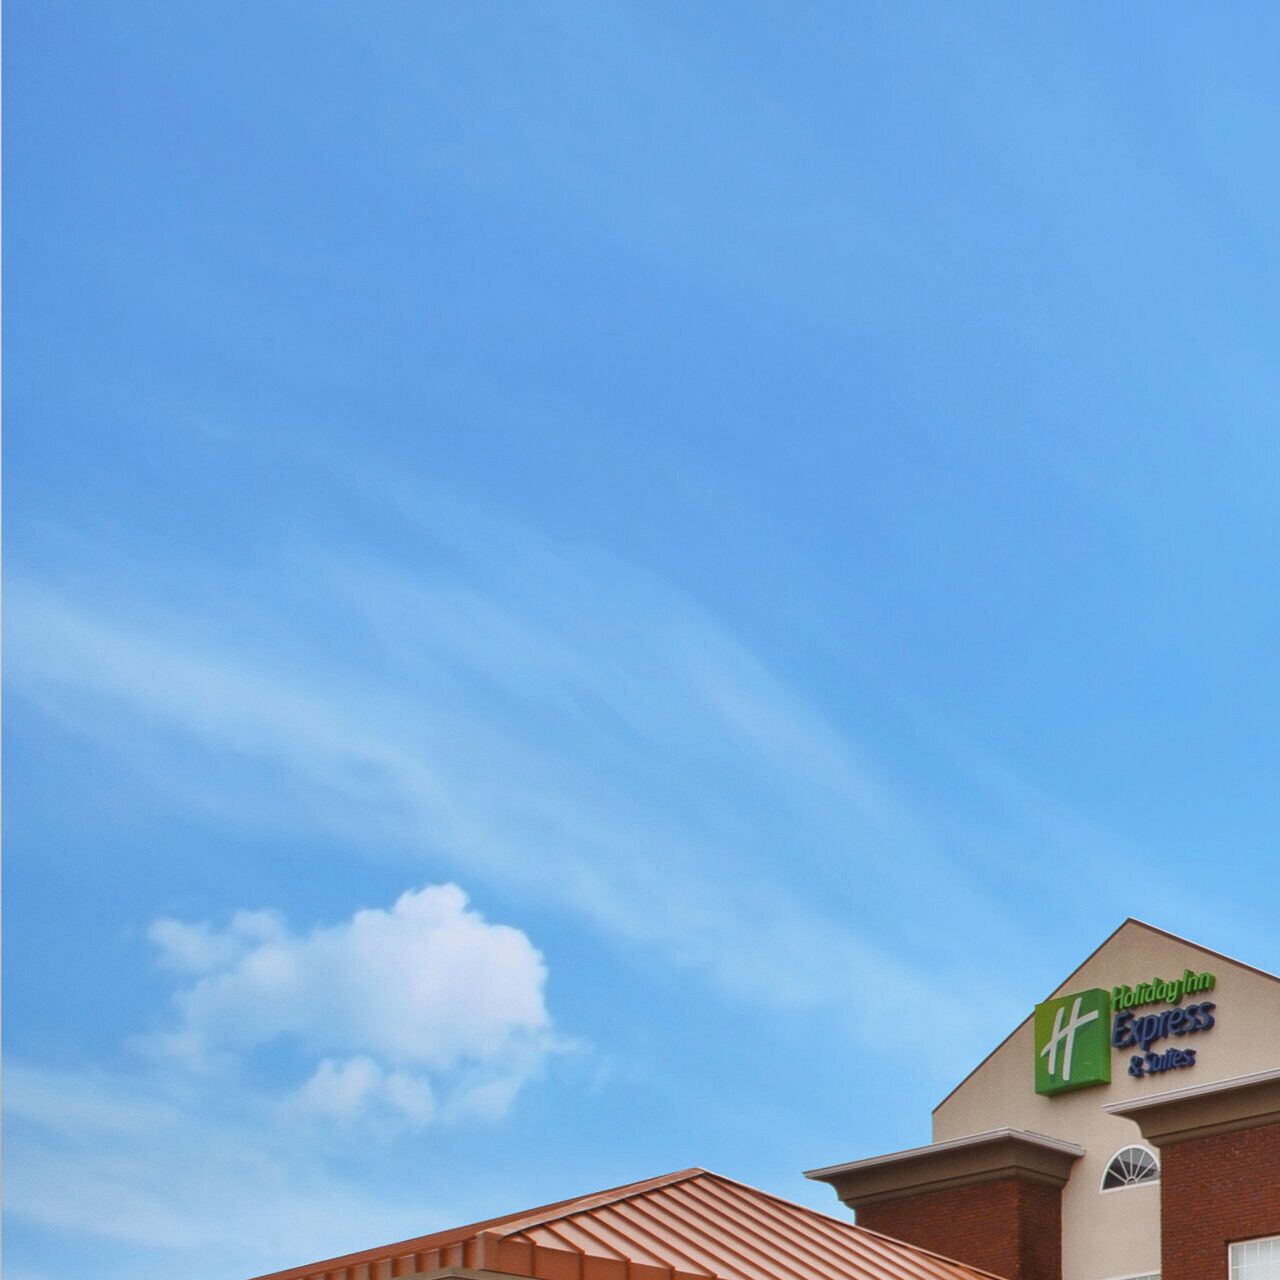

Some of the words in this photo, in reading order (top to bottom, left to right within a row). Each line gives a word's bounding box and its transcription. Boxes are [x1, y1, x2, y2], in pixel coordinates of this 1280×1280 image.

[1111, 977, 1183, 1010] Holiday
[1182, 969, 1216, 994] Inn
[1112, 1002, 1216, 1051] Express
[1128, 1055, 1145, 1077] &
[1144, 1048, 1197, 1073] Suites
